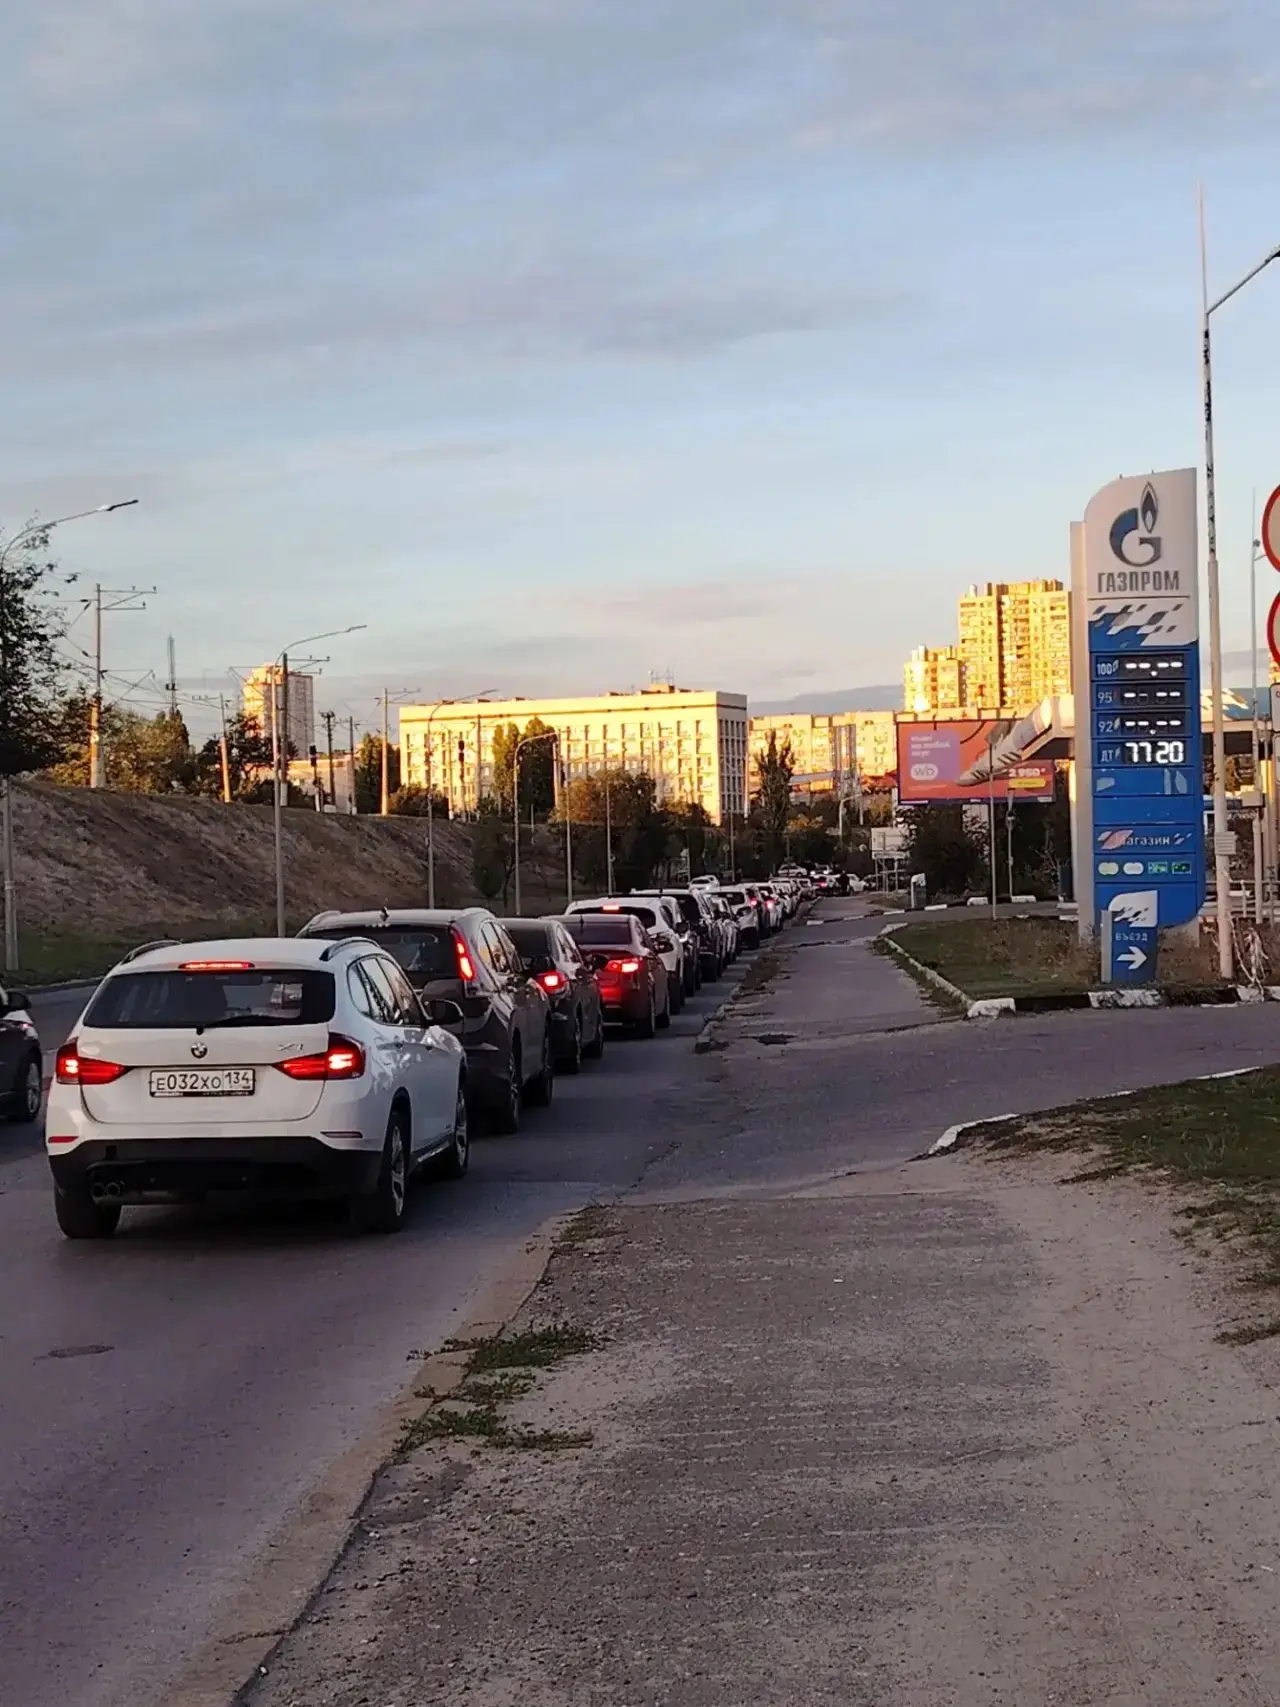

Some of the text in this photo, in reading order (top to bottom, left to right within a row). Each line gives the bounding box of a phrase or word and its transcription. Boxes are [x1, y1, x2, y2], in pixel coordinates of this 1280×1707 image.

[1097, 570, 1180, 594] ГАЗПРОМ
[1097, 663, 1112, 676] 100
[1097, 692, 1113, 704] 95
[1098, 721, 1113, 733] 92
[1101, 750, 1114, 762] ДТ
[1123, 836, 1170, 846] агазин
[1115, 932, 1148, 942] ВЪЕЗД
[225, 1072, 250, 1084] 134
